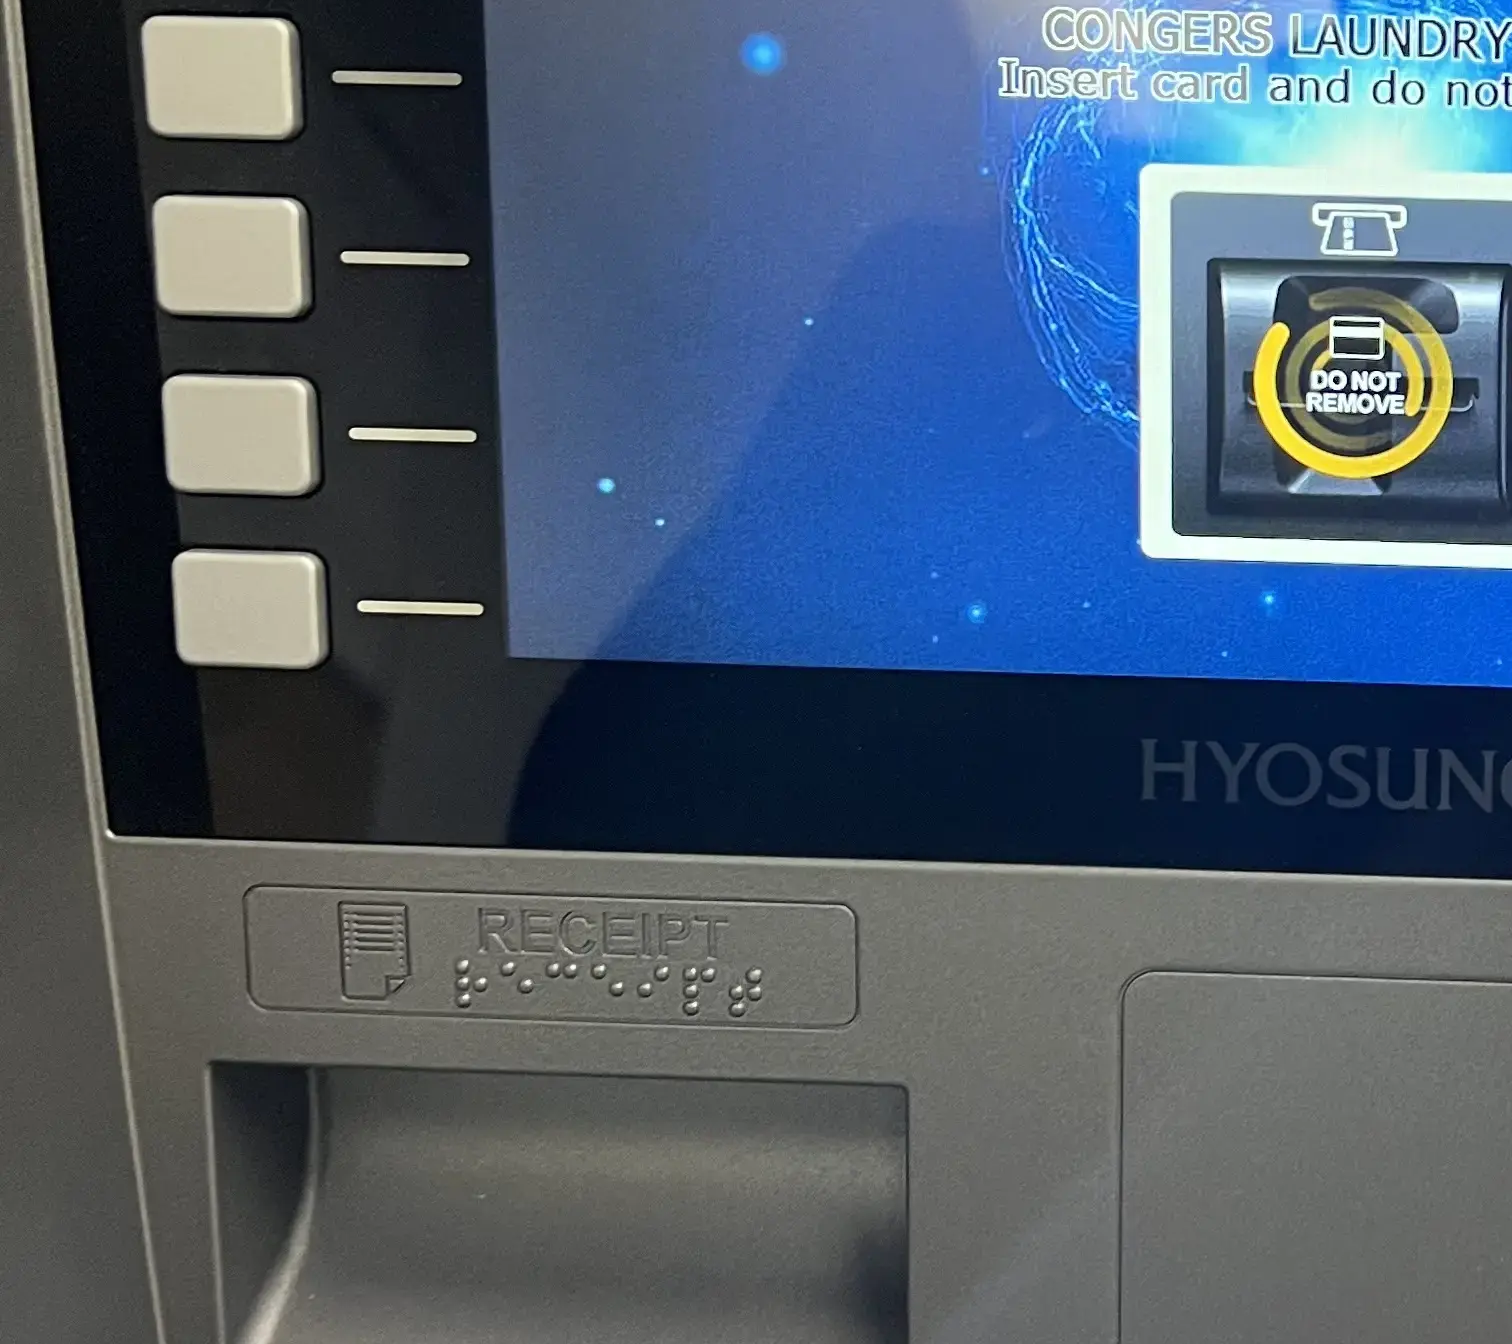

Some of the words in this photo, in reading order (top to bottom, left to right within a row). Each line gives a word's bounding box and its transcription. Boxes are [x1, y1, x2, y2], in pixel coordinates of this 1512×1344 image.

[1043, 7, 1272, 56] CONGERS
[999, 57, 1135, 100] Insert
[1152, 62, 1248, 102] card
[1269, 66, 1350, 106] and
[1372, 68, 1426, 107] do
[1305, 392, 1406, 415] REMOVE
[1310, 370, 1347, 391] DO
[1351, 370, 1402, 392] NOT
[475, 907, 731, 960] RECEIPT
